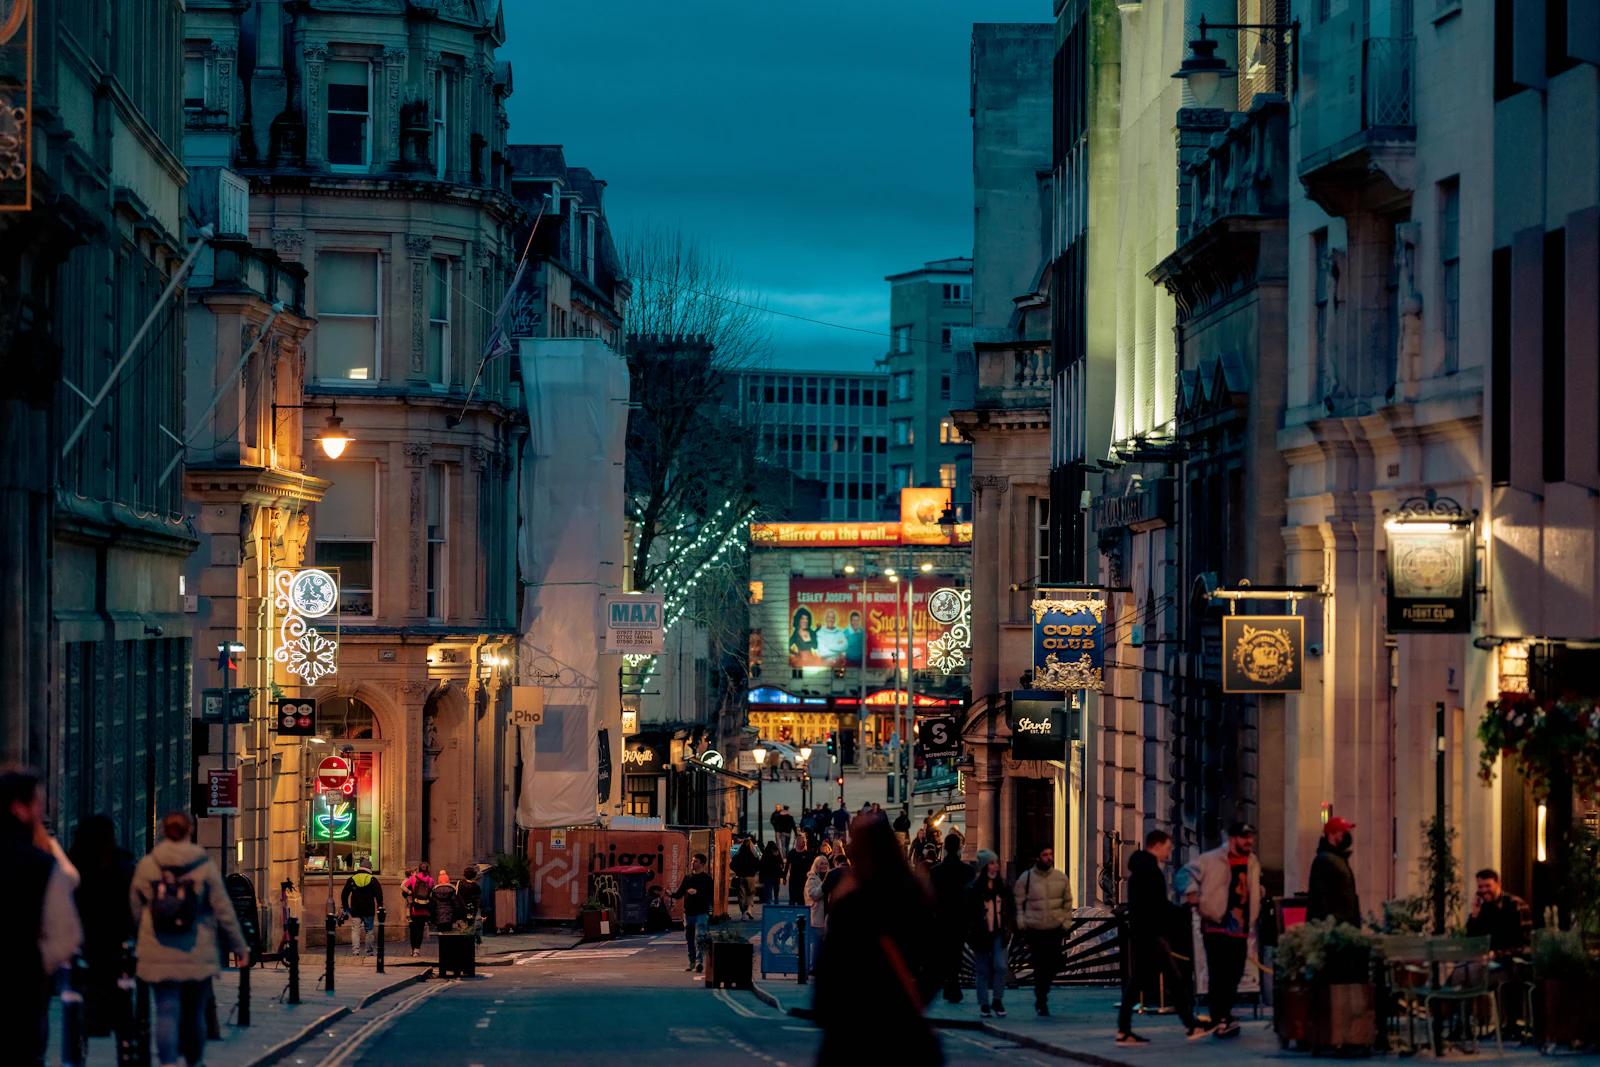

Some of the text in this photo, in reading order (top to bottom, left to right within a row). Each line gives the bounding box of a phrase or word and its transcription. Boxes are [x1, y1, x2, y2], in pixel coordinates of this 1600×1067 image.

[779, 527, 818, 541] Mirror
[820, 530, 836, 541] on
[838, 528, 859, 541] the
[797, 592, 824, 602] LESLEY
[826, 592, 853, 603] JOSEPH
[874, 593, 901, 603] RINDE
[612, 604, 657, 622] MAX
[1433, 608, 1454, 619] CLUB
[1043, 625, 1096, 636] COSY
[1043, 638, 1095, 649] CLUB
[514, 710, 541, 722] Pho
[1018, 717, 1052, 735] Stanfo
[925, 750, 958, 759] screenology
